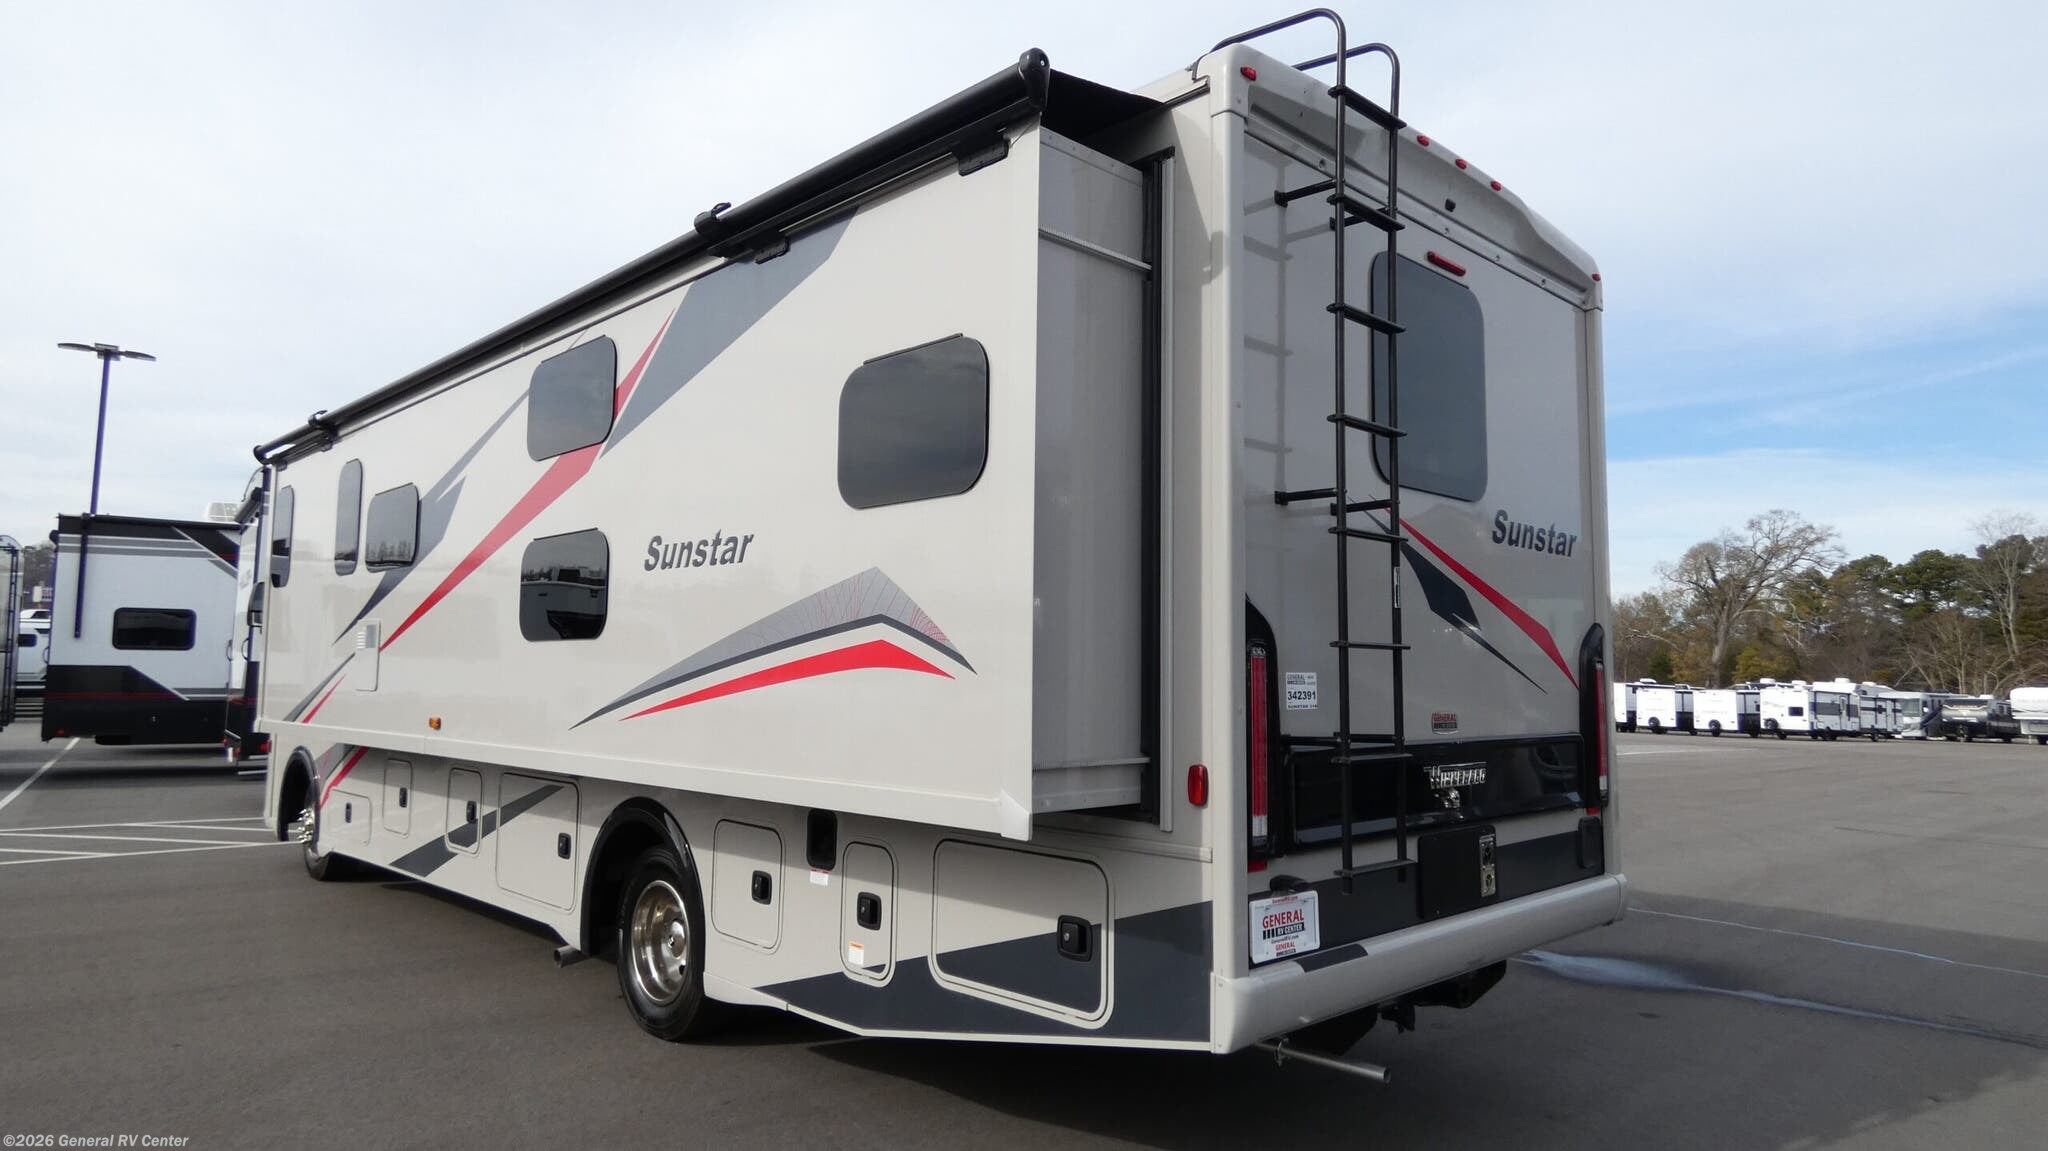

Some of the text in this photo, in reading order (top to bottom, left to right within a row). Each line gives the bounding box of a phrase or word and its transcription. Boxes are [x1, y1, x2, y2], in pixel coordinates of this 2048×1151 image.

[1492, 509, 1577, 557] Sunstar
[644, 528, 755, 572] Sunstar
[1287, 690, 1316, 701] 342391
[1262, 908, 1304, 929] GENERAL
[1277, 923, 1303, 937] RV CENTER
[1276, 941, 1295, 951] GENERAL
